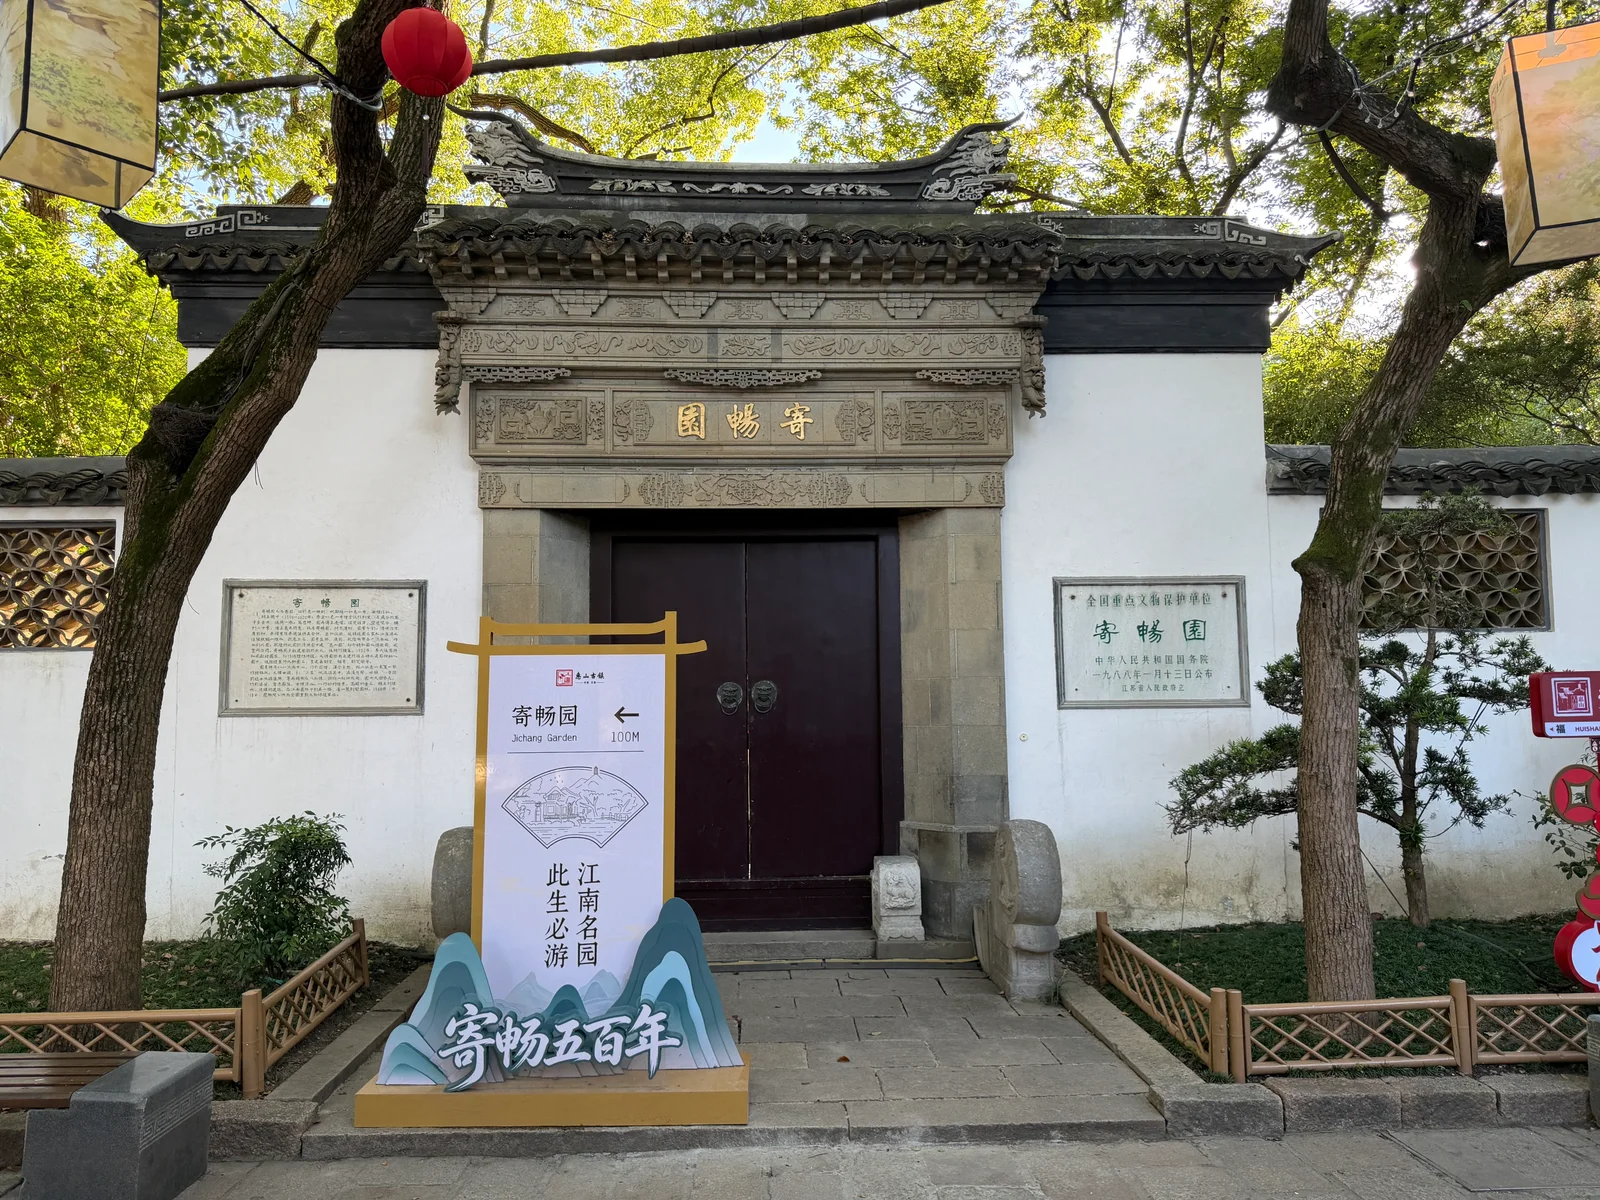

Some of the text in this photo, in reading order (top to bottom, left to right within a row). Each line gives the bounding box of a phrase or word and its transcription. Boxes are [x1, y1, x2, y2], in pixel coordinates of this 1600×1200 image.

[1087, 592, 1211, 607] 全国重点文物保护单位
[1095, 654, 1209, 666] 中华人民共和国国务院
[1092, 668, 1213, 680] 一九八八年一月十三日公布
[512, 705, 577, 727] 寄畅园
[511, 733, 578, 744] Jichang Garden
[611, 731, 640, 742] 100M
[544, 863, 569, 968] 此生必游
[576, 862, 600, 967] 江南名园
[438, 1003, 682, 1092] 寄畅五百年
